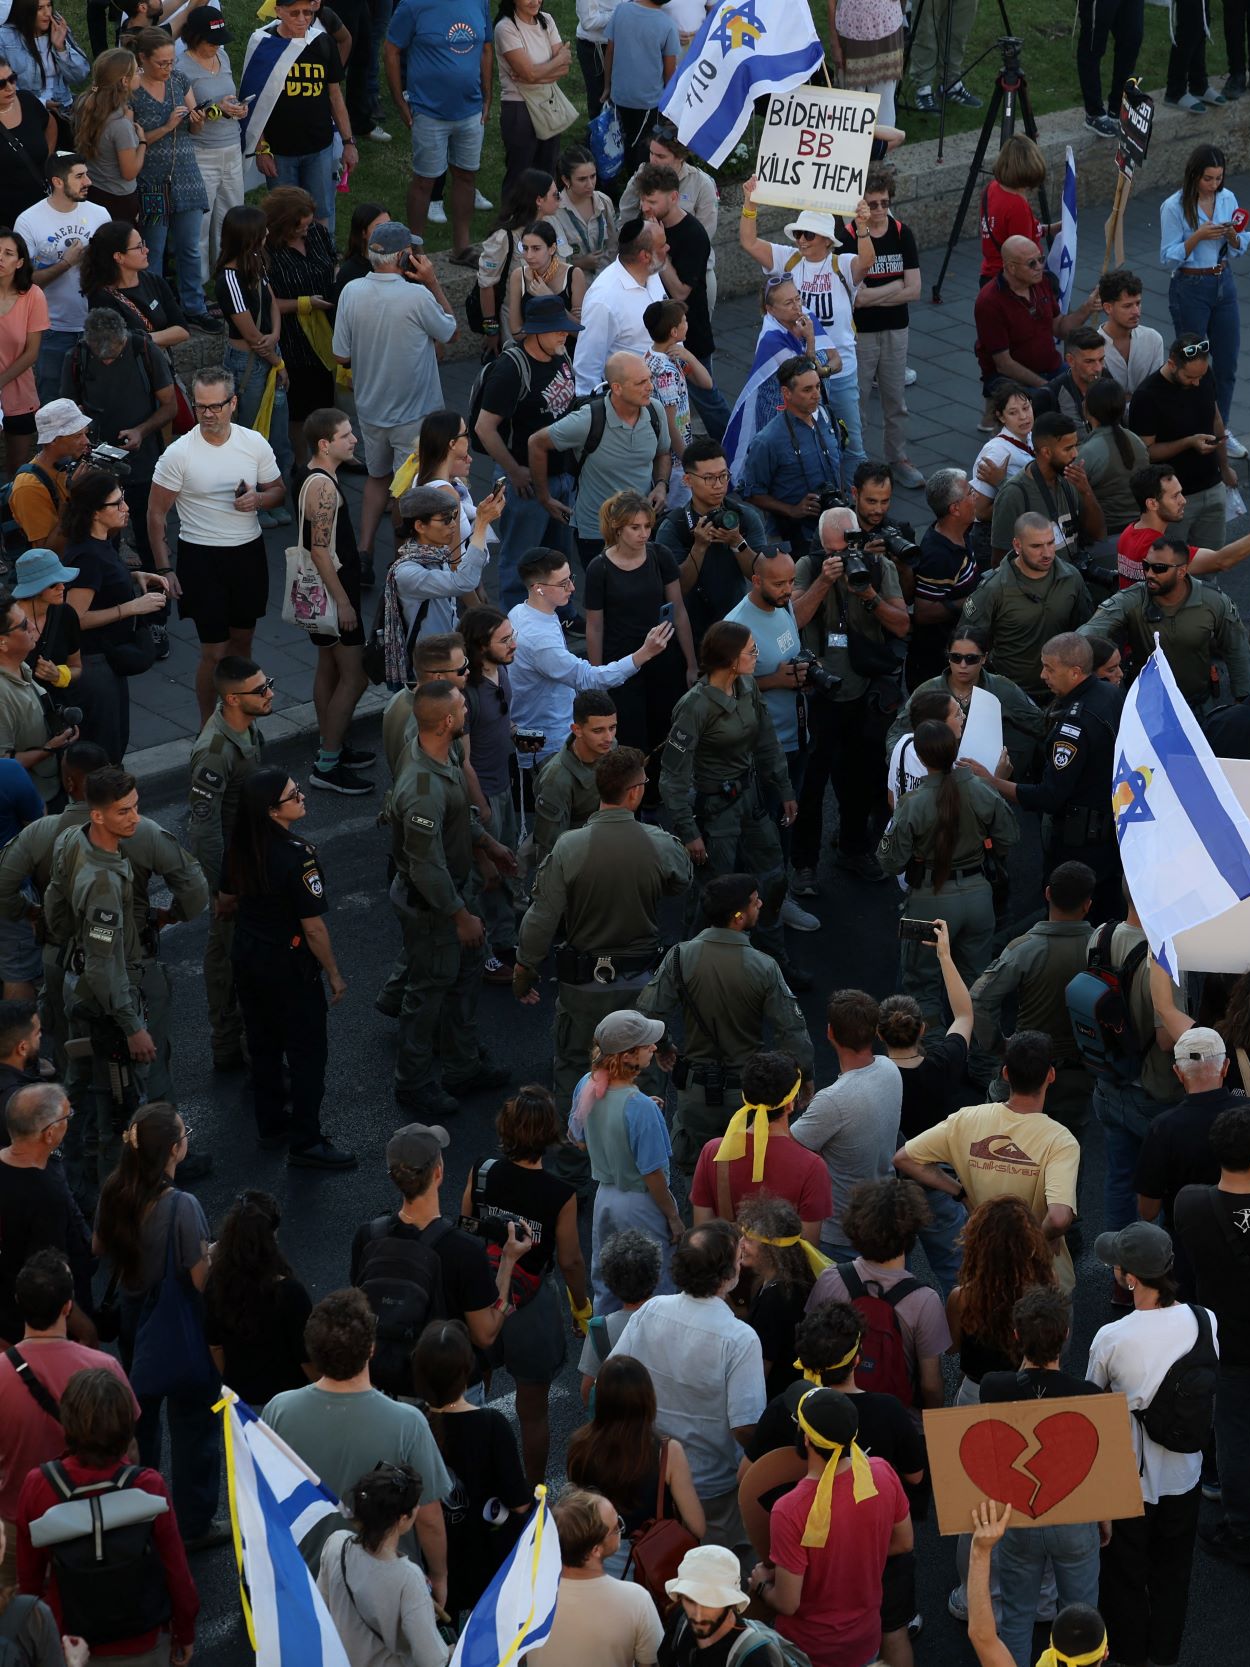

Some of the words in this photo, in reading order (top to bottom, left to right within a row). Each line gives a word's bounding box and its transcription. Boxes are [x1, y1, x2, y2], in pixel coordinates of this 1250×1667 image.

[287, 63, 325, 79] הדח
[286, 81, 324, 97] עכש
[797, 129, 834, 158] BB
[757, 153, 805, 186] KILLS
[812, 162, 864, 196] THEM
